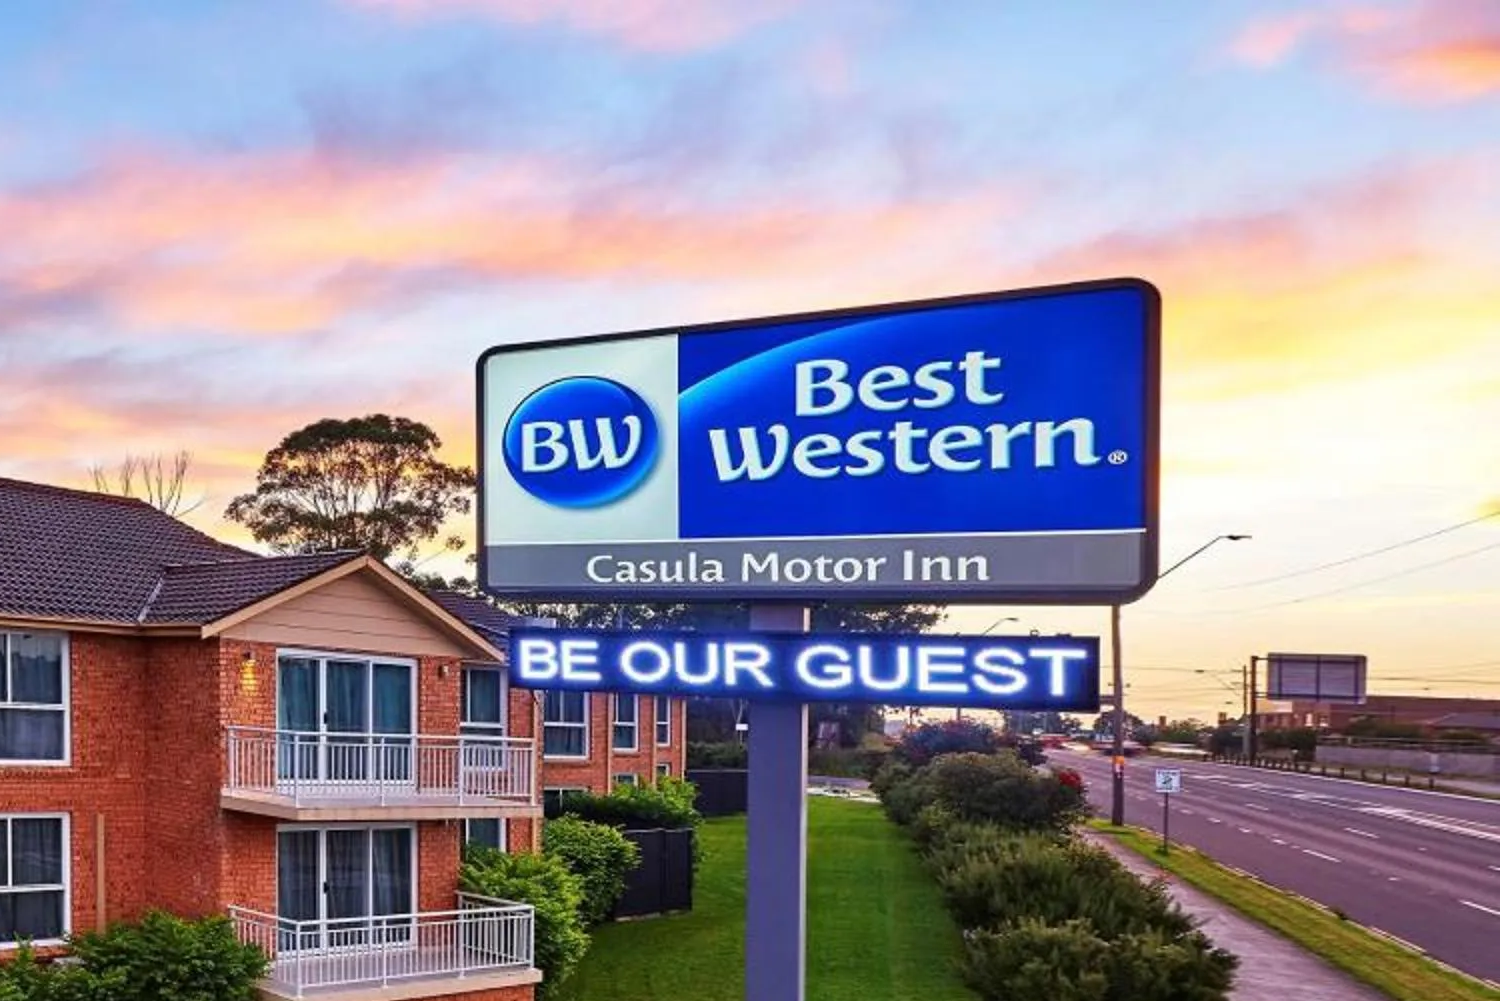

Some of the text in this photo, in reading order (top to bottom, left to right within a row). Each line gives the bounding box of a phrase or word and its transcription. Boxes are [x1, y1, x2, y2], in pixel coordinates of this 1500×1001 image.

[795, 350, 1004, 418] Best
[519, 413, 644, 475] BW
[707, 414, 1102, 484] Western
[586, 548, 990, 585] Casula Motor Inn
[517, 637, 1088, 698] BE OUR GUEST
